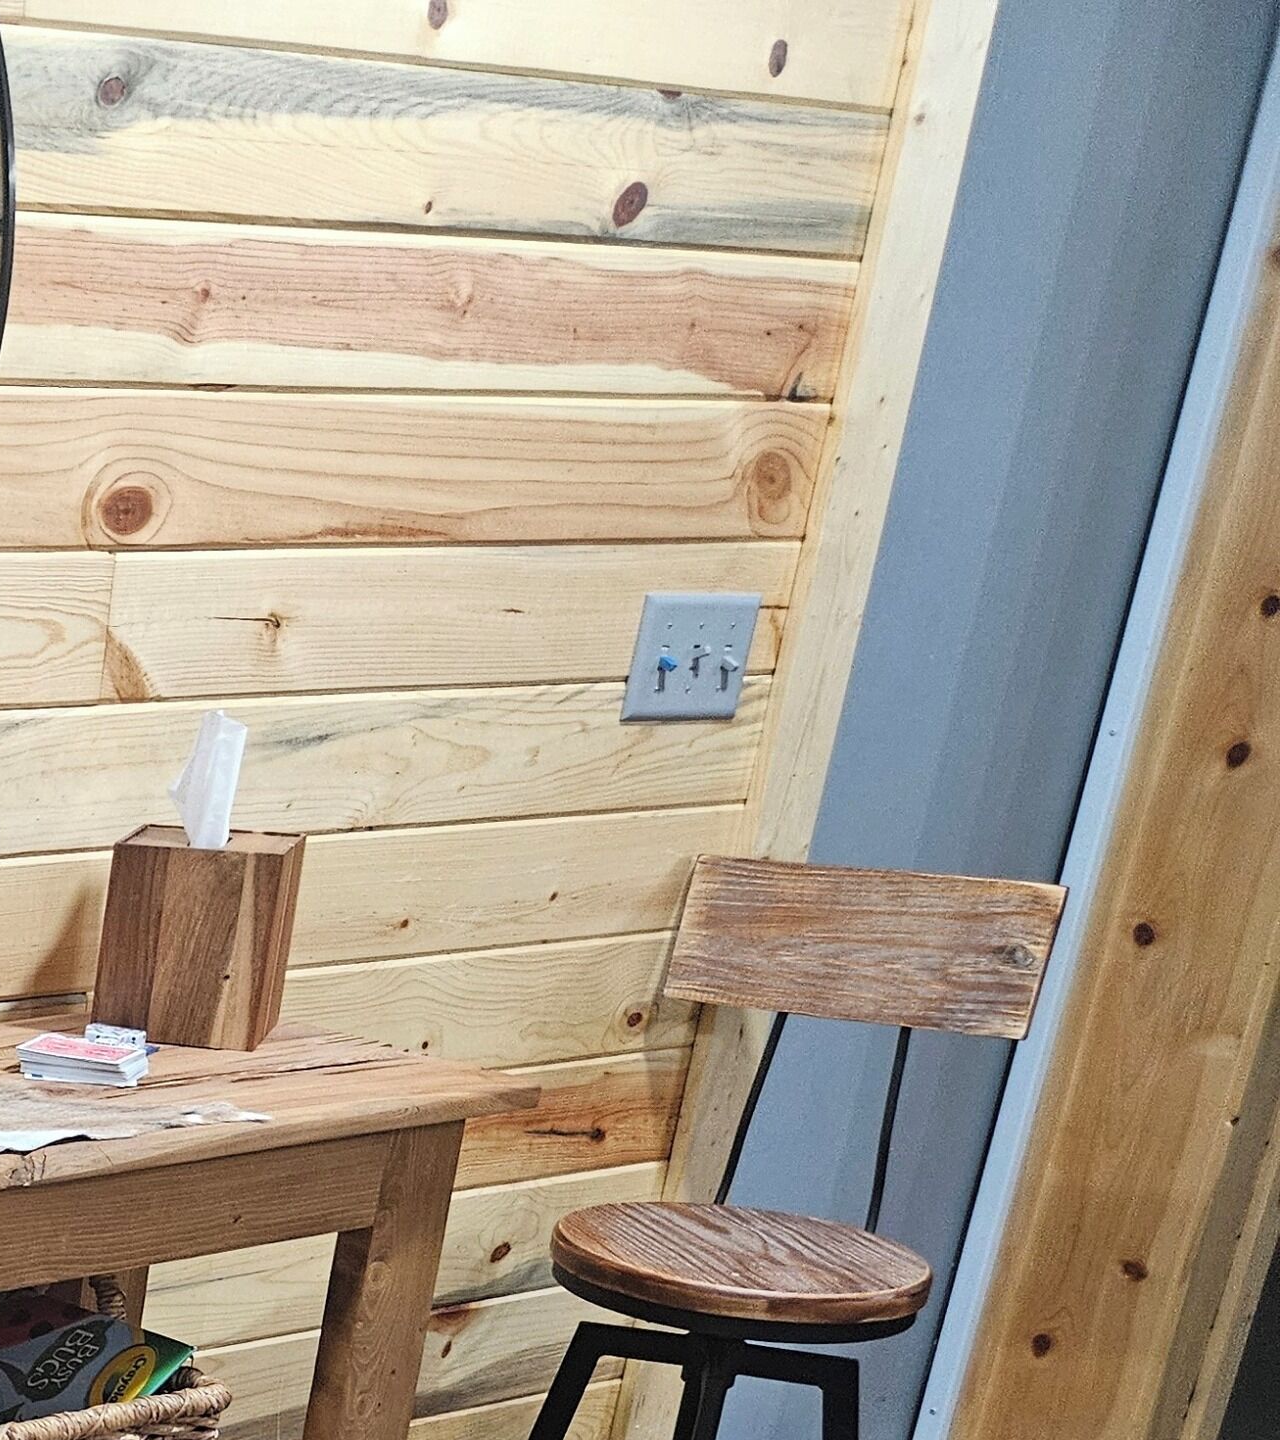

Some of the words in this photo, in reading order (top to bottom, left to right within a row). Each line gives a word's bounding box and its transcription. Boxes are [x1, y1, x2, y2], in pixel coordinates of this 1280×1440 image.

[27, 1329, 94, 1390] BUGS
[51, 1344, 100, 1388] BUSY
[109, 1353, 147, 1403] Crayola
